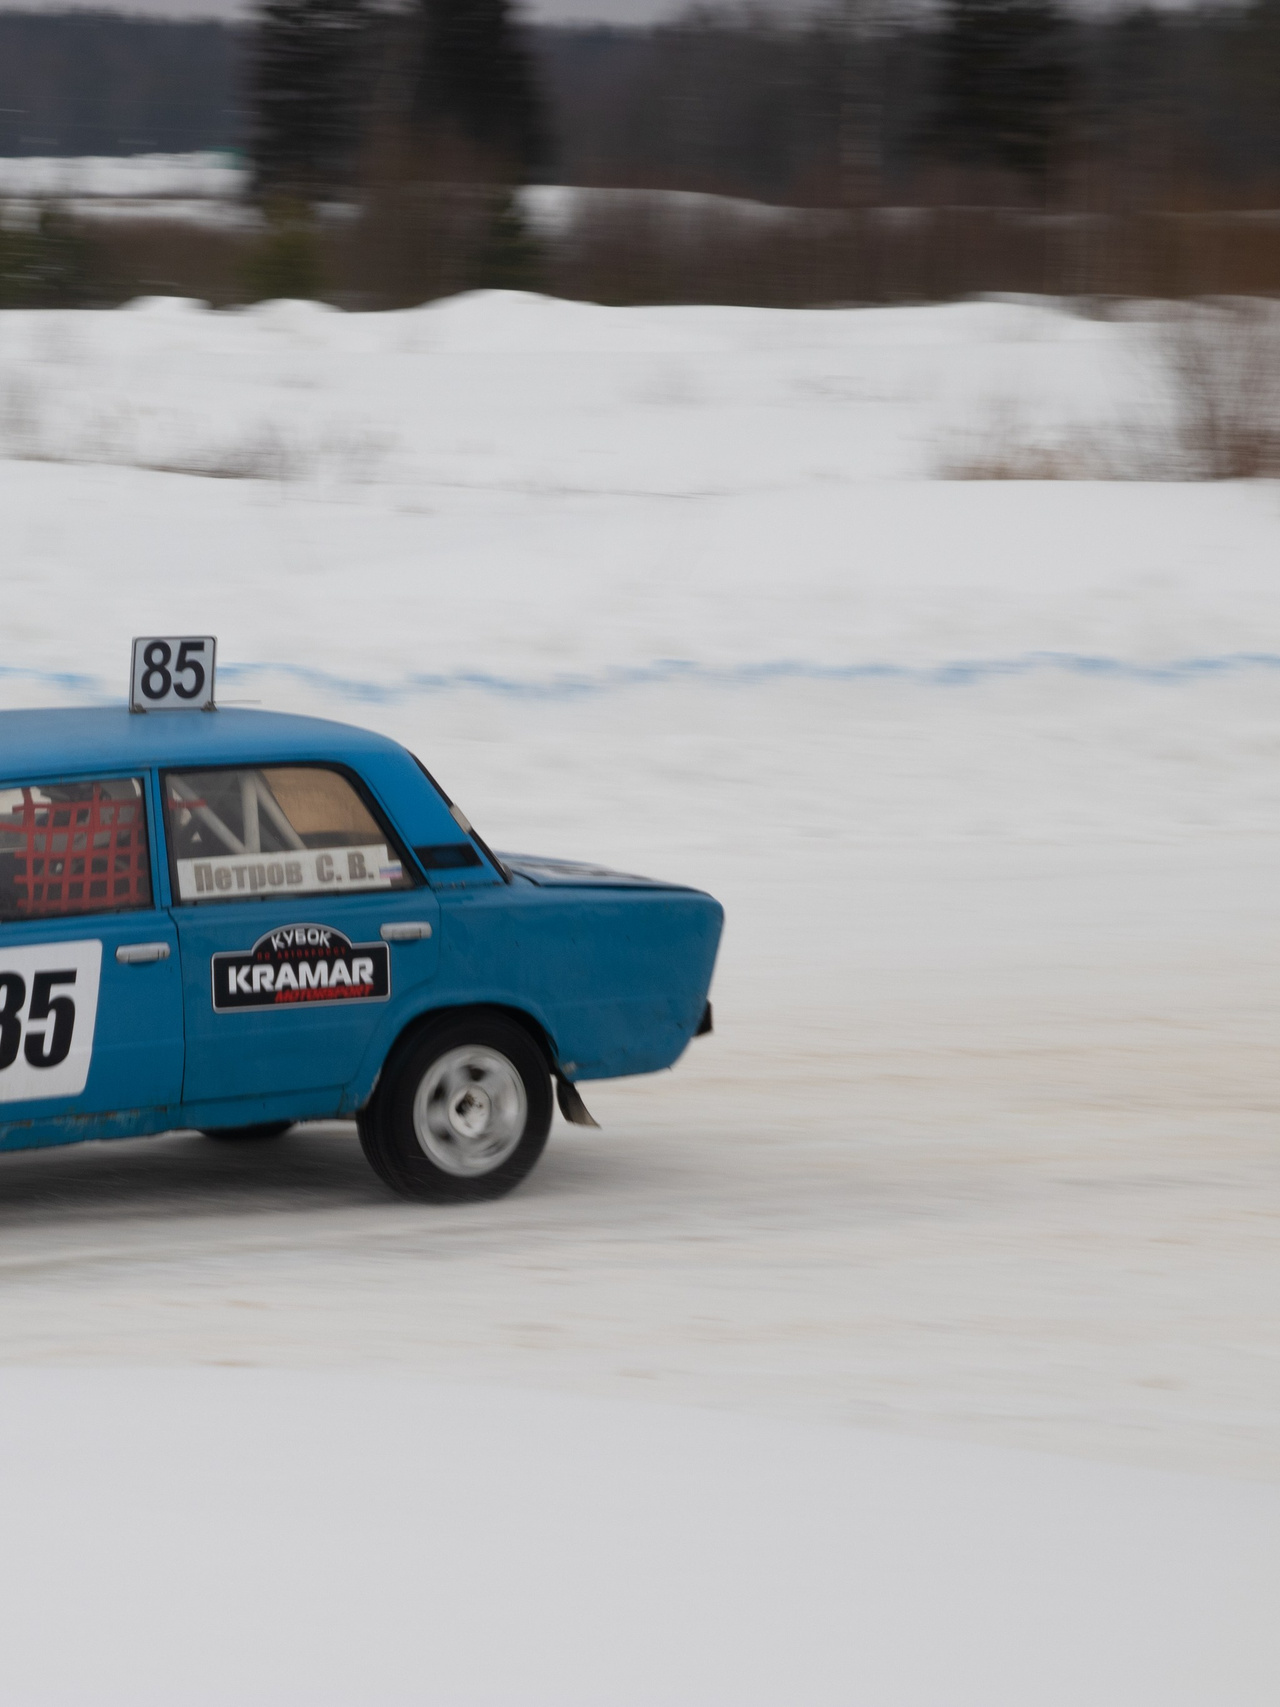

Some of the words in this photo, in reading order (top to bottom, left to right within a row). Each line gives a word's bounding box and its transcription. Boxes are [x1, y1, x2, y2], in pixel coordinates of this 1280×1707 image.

[141, 640, 205, 699] 85
[193, 860, 304, 893] Петров
[271, 927, 333, 951] КУБОК
[228, 956, 375, 995] KRAMAR
